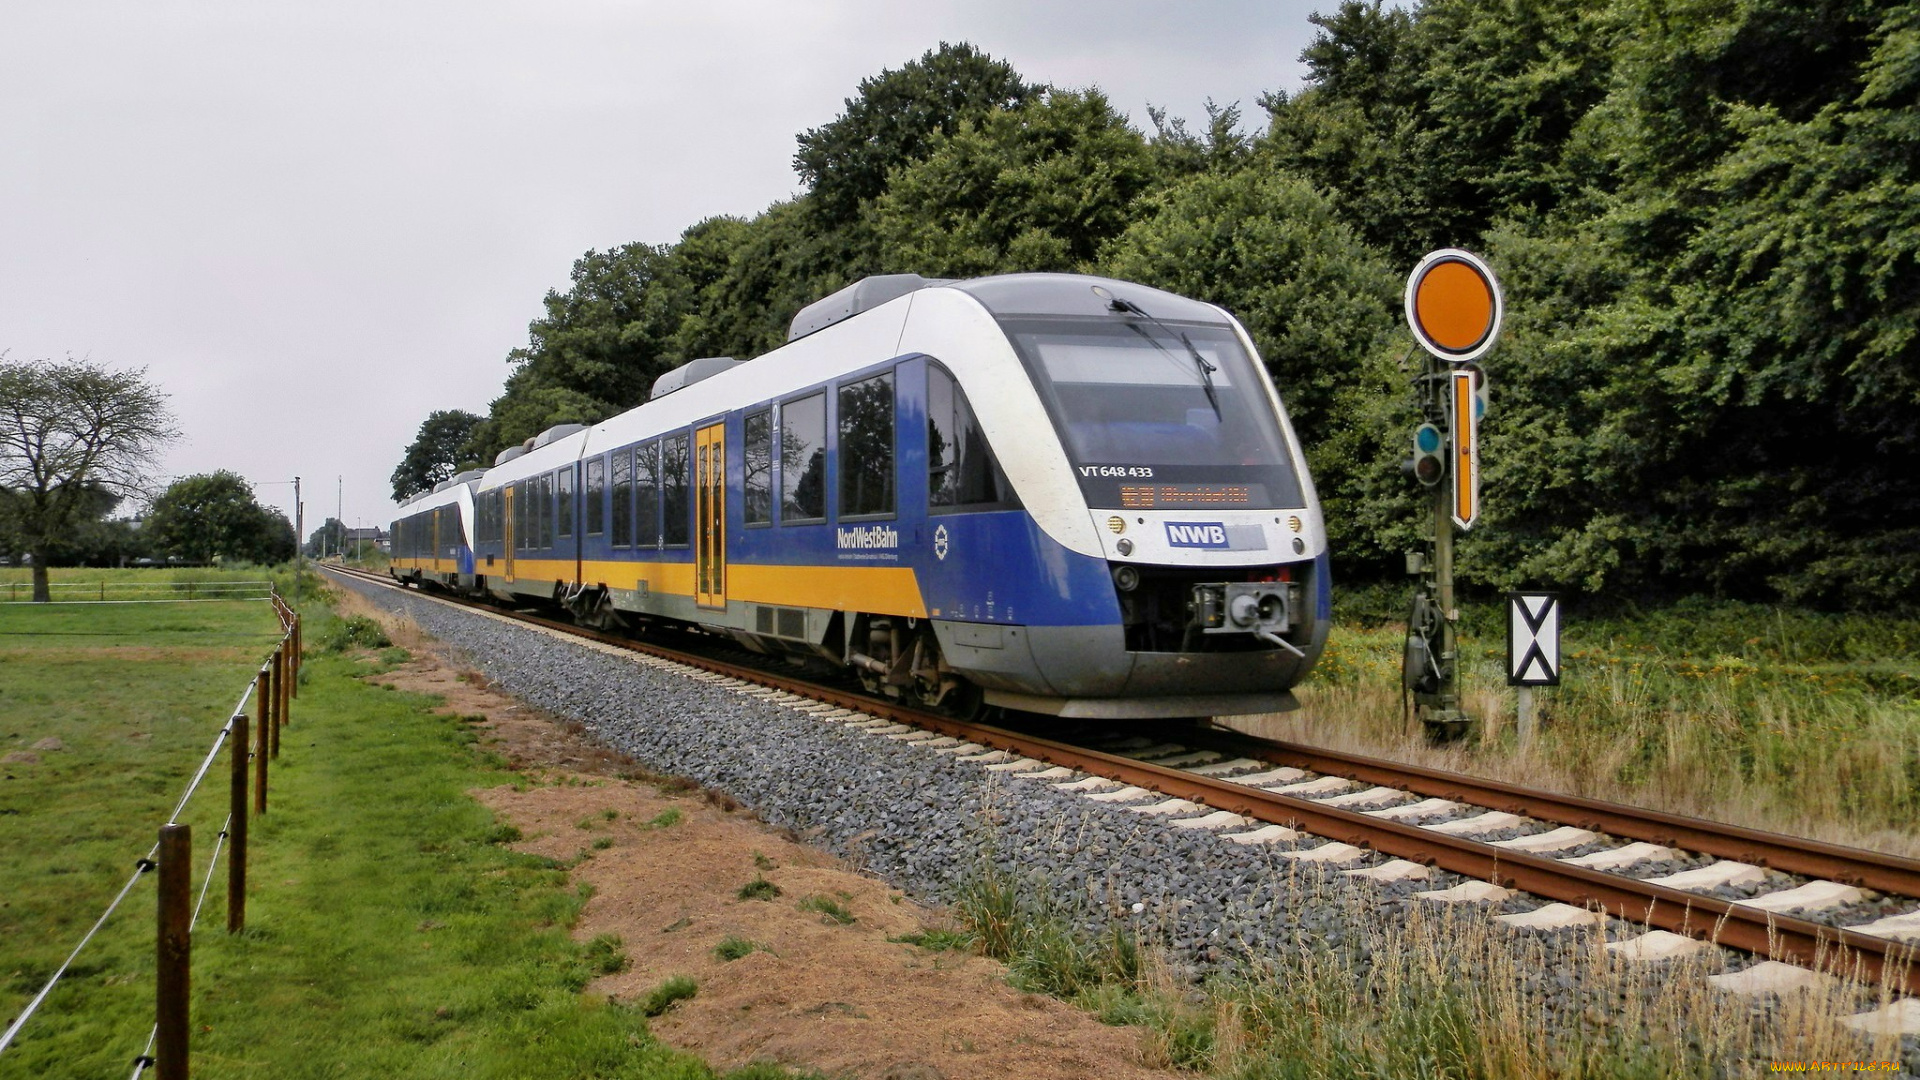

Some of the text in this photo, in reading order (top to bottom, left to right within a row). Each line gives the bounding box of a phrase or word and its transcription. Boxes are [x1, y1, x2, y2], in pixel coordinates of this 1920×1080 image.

[772, 404, 779, 431] 2
[1079, 466, 1153, 478] VT 648 433
[837, 525, 898, 549] NordWestBahn
[1168, 525, 1226, 544] NWB
